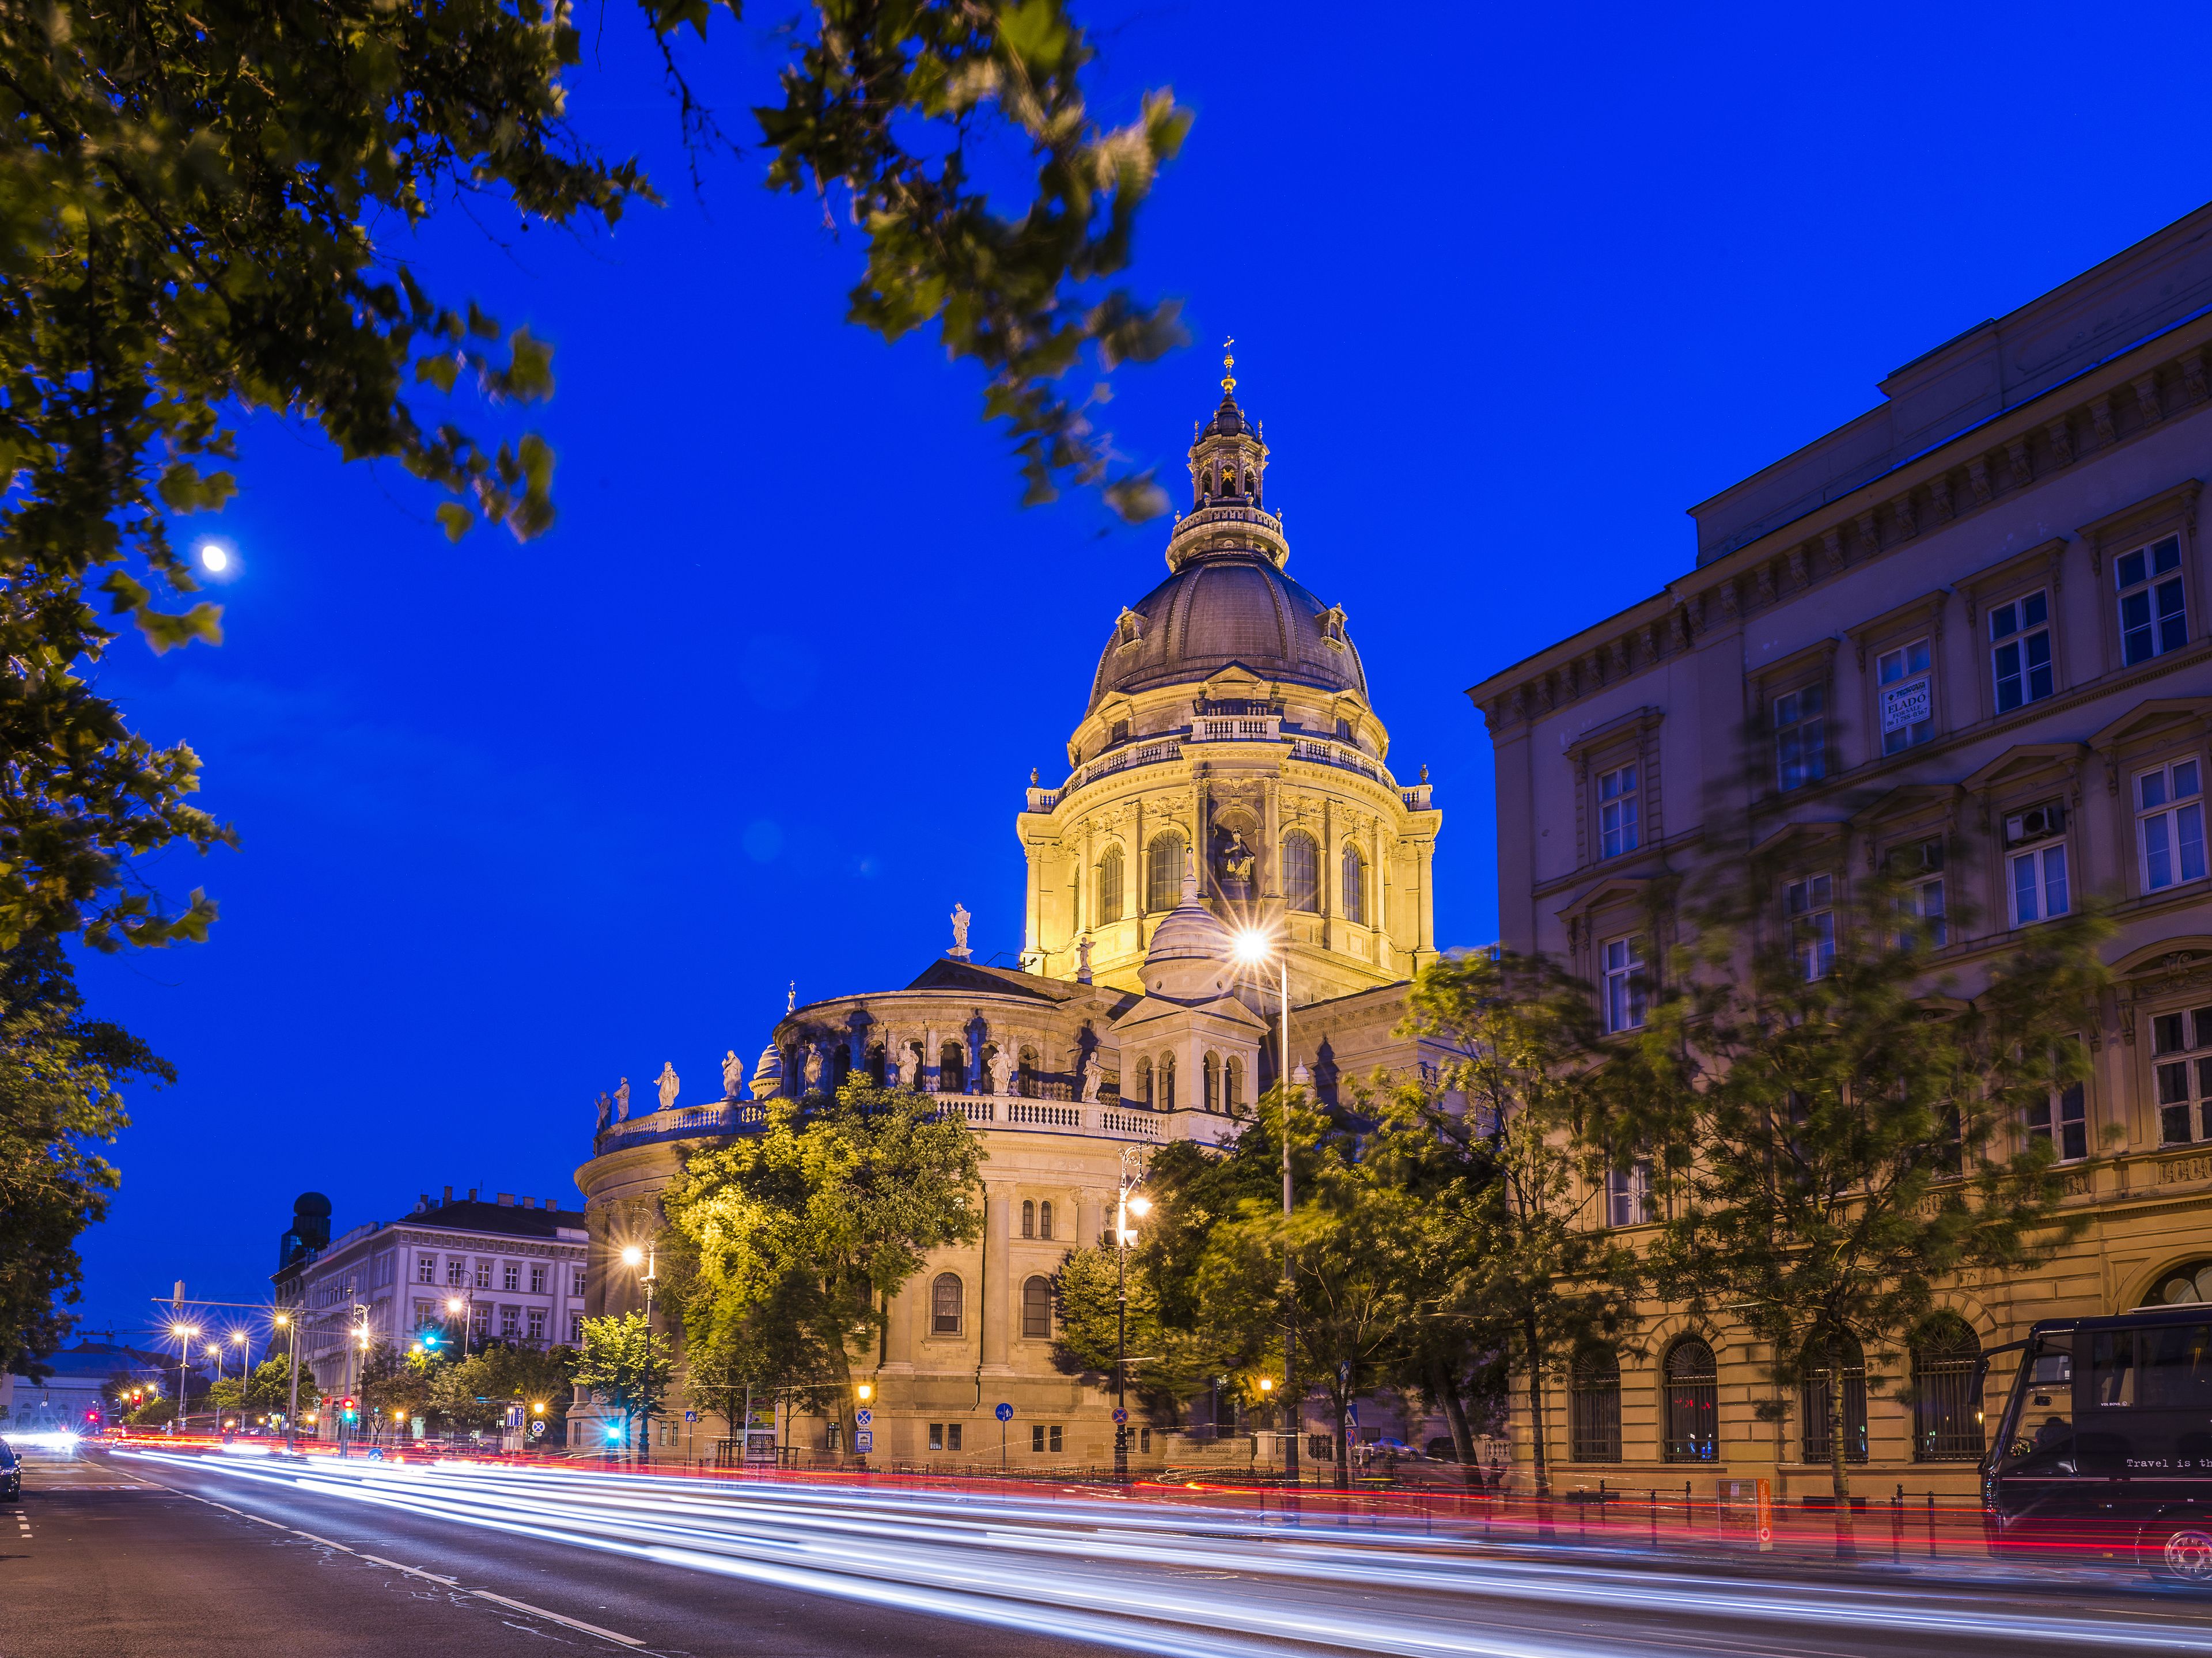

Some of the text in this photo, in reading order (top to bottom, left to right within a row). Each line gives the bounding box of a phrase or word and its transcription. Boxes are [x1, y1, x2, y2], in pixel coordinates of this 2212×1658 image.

[1888, 692, 1926, 714] ELADÓ
[1893, 704, 1921, 719] FOR SALE
[2127, 1459, 2169, 1467] Travel
[2177, 1459, 2191, 1467] is
